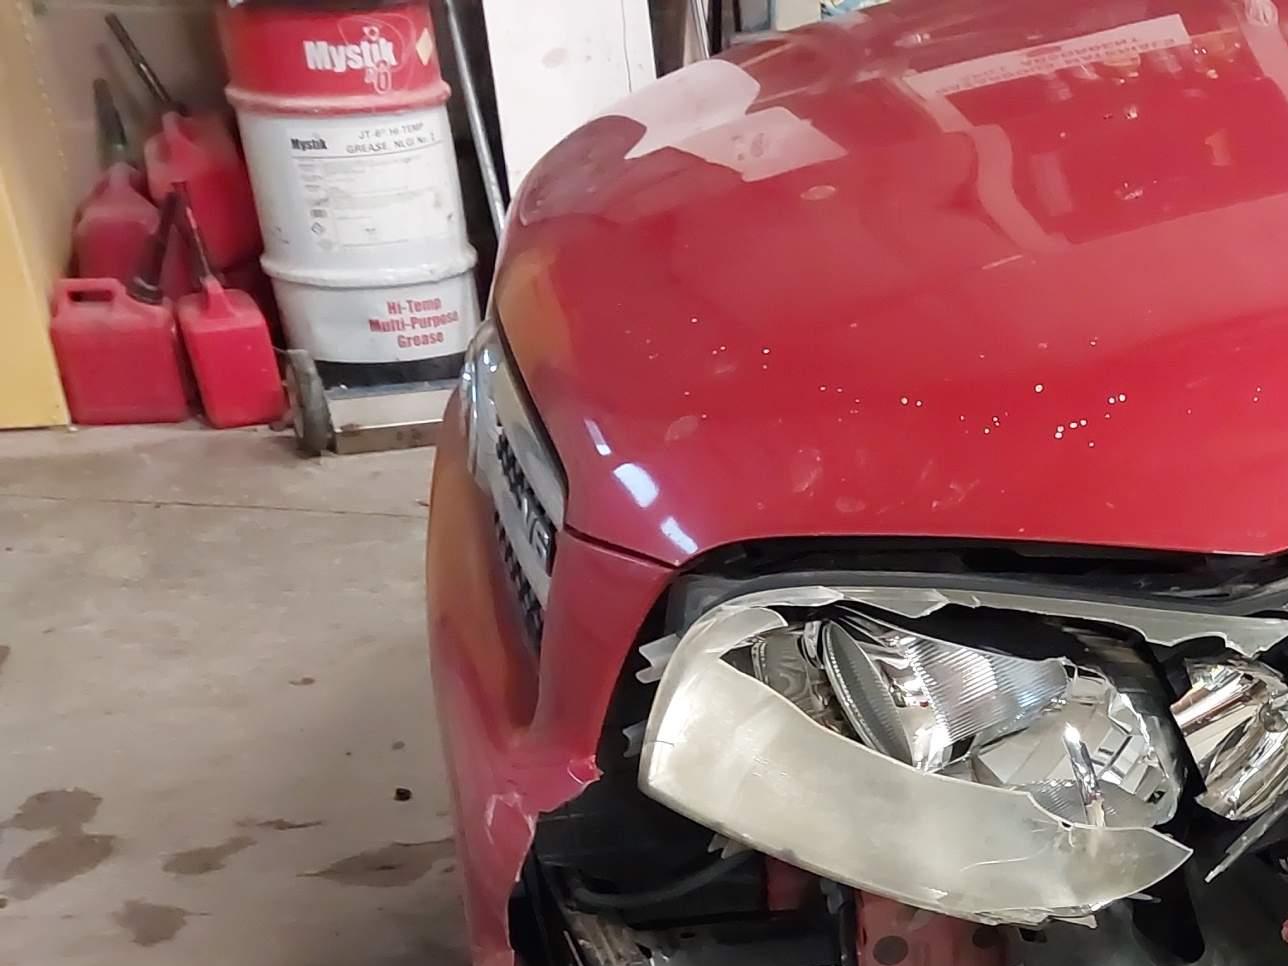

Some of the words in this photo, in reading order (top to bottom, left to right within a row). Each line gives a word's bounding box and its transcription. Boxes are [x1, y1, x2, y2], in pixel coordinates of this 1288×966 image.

[302, 27, 398, 74] Mystik
[386, 298, 442, 315] Hi-Temp
[368, 310, 459, 333] Multi-Purpose
[397, 330, 445, 349] Grease
